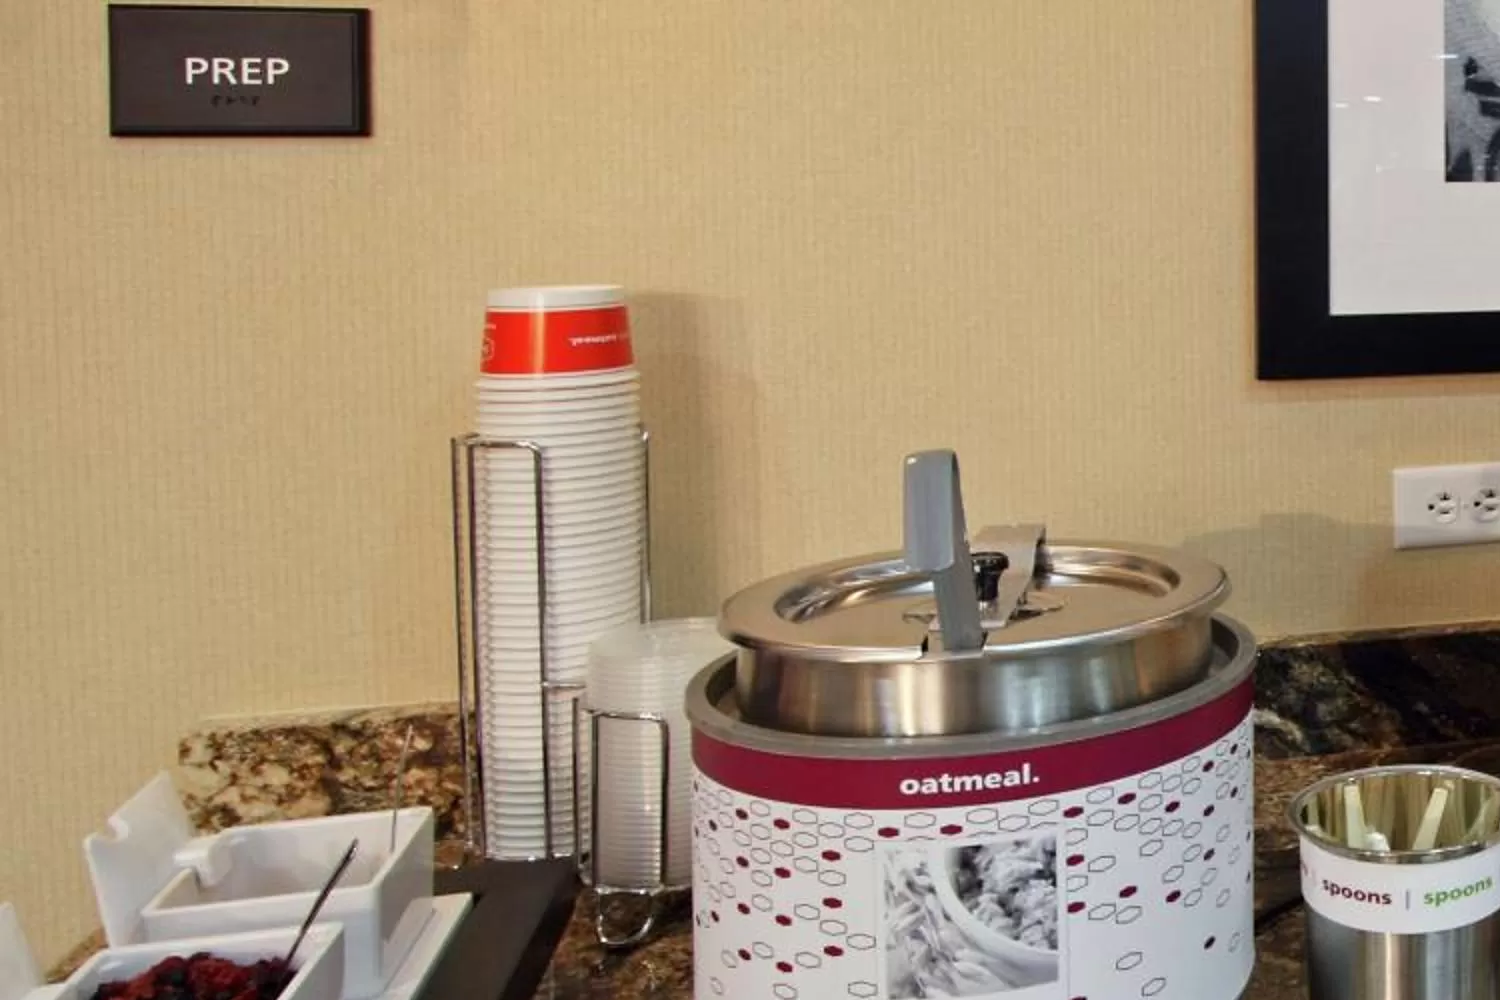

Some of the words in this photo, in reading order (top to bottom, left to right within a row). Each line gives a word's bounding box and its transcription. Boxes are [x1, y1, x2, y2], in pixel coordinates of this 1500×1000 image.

[184, 56, 290, 85] PREP
[899, 762, 1041, 795] oatmeal.
[1321, 878, 1393, 905] spoons
[1423, 875, 1493, 907] spoons
